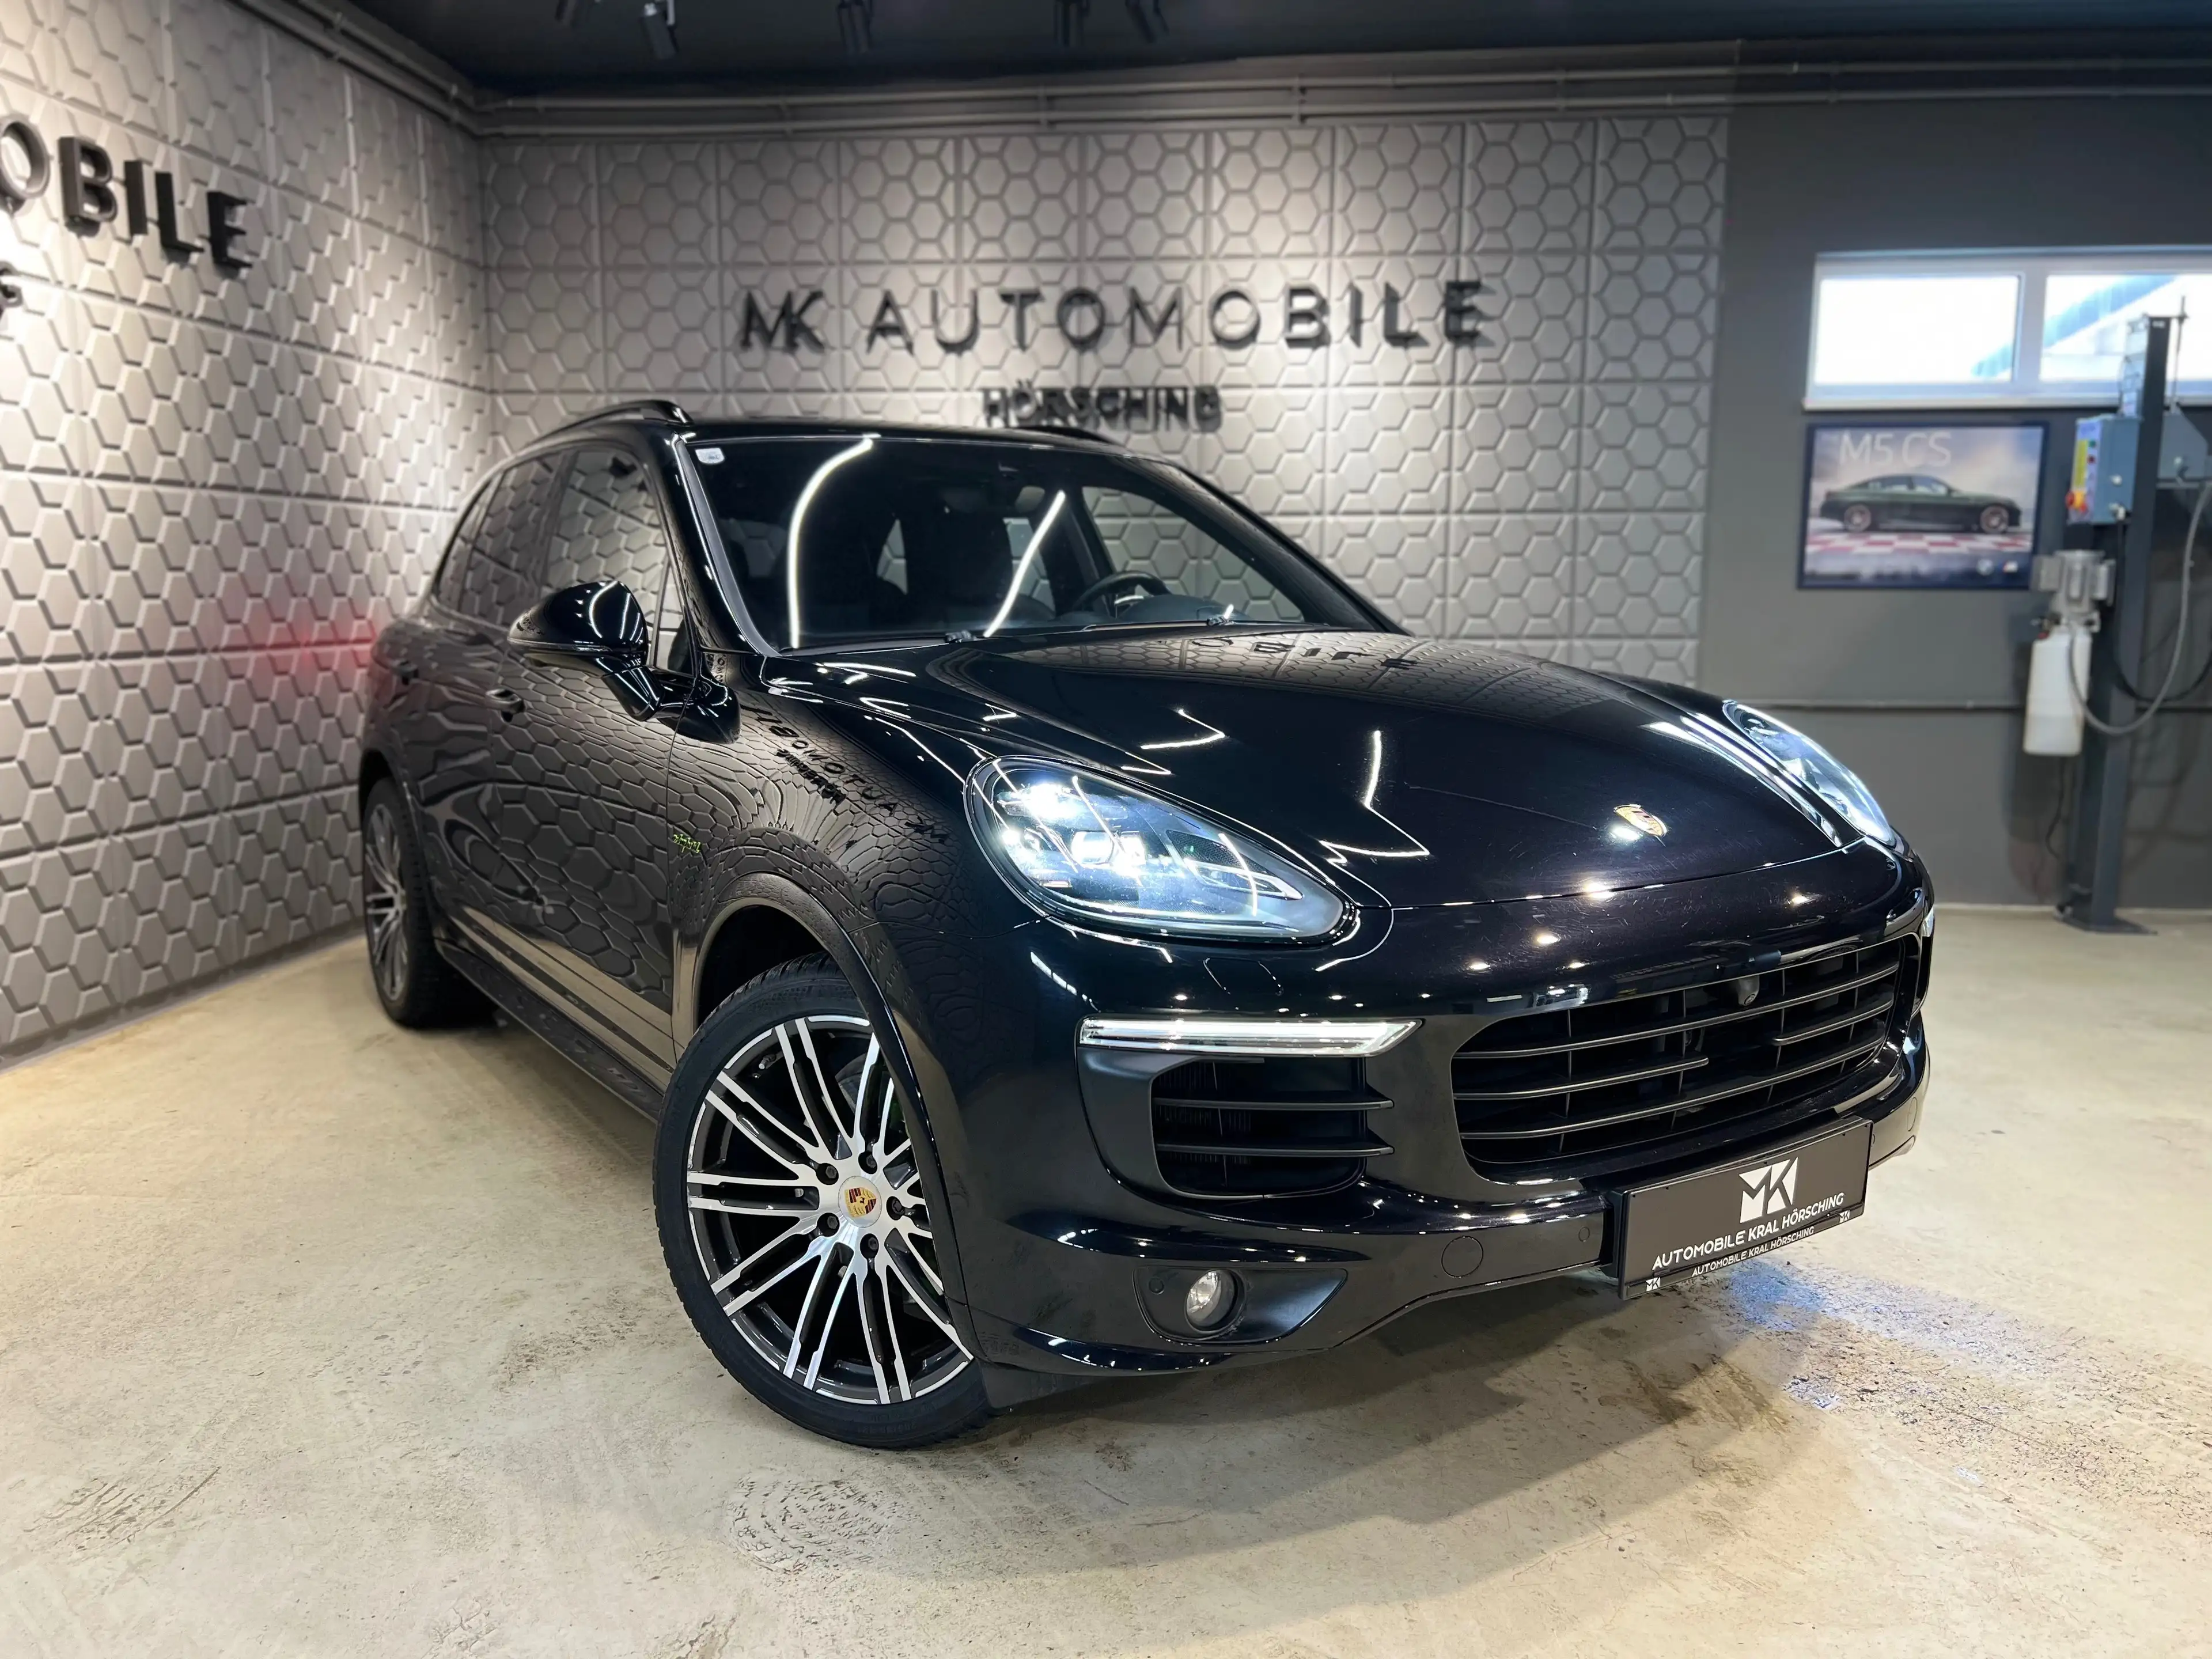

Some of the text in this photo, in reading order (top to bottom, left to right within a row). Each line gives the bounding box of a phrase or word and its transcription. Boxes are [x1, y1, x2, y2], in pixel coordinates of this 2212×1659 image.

[741, 280, 1488, 355] MK AUTOMOBILE
[982, 380, 1221, 430] HÖRSCHING
[1839, 430, 1952, 468] M5 CS
[1738, 1157, 1798, 1224] MK
[1652, 1192, 1844, 1271] AUTOMOBILE KRAL HÖRSCHING
[1691, 1225, 1815, 1278] AUTOMOBILE KRAL HÖRSCHING
